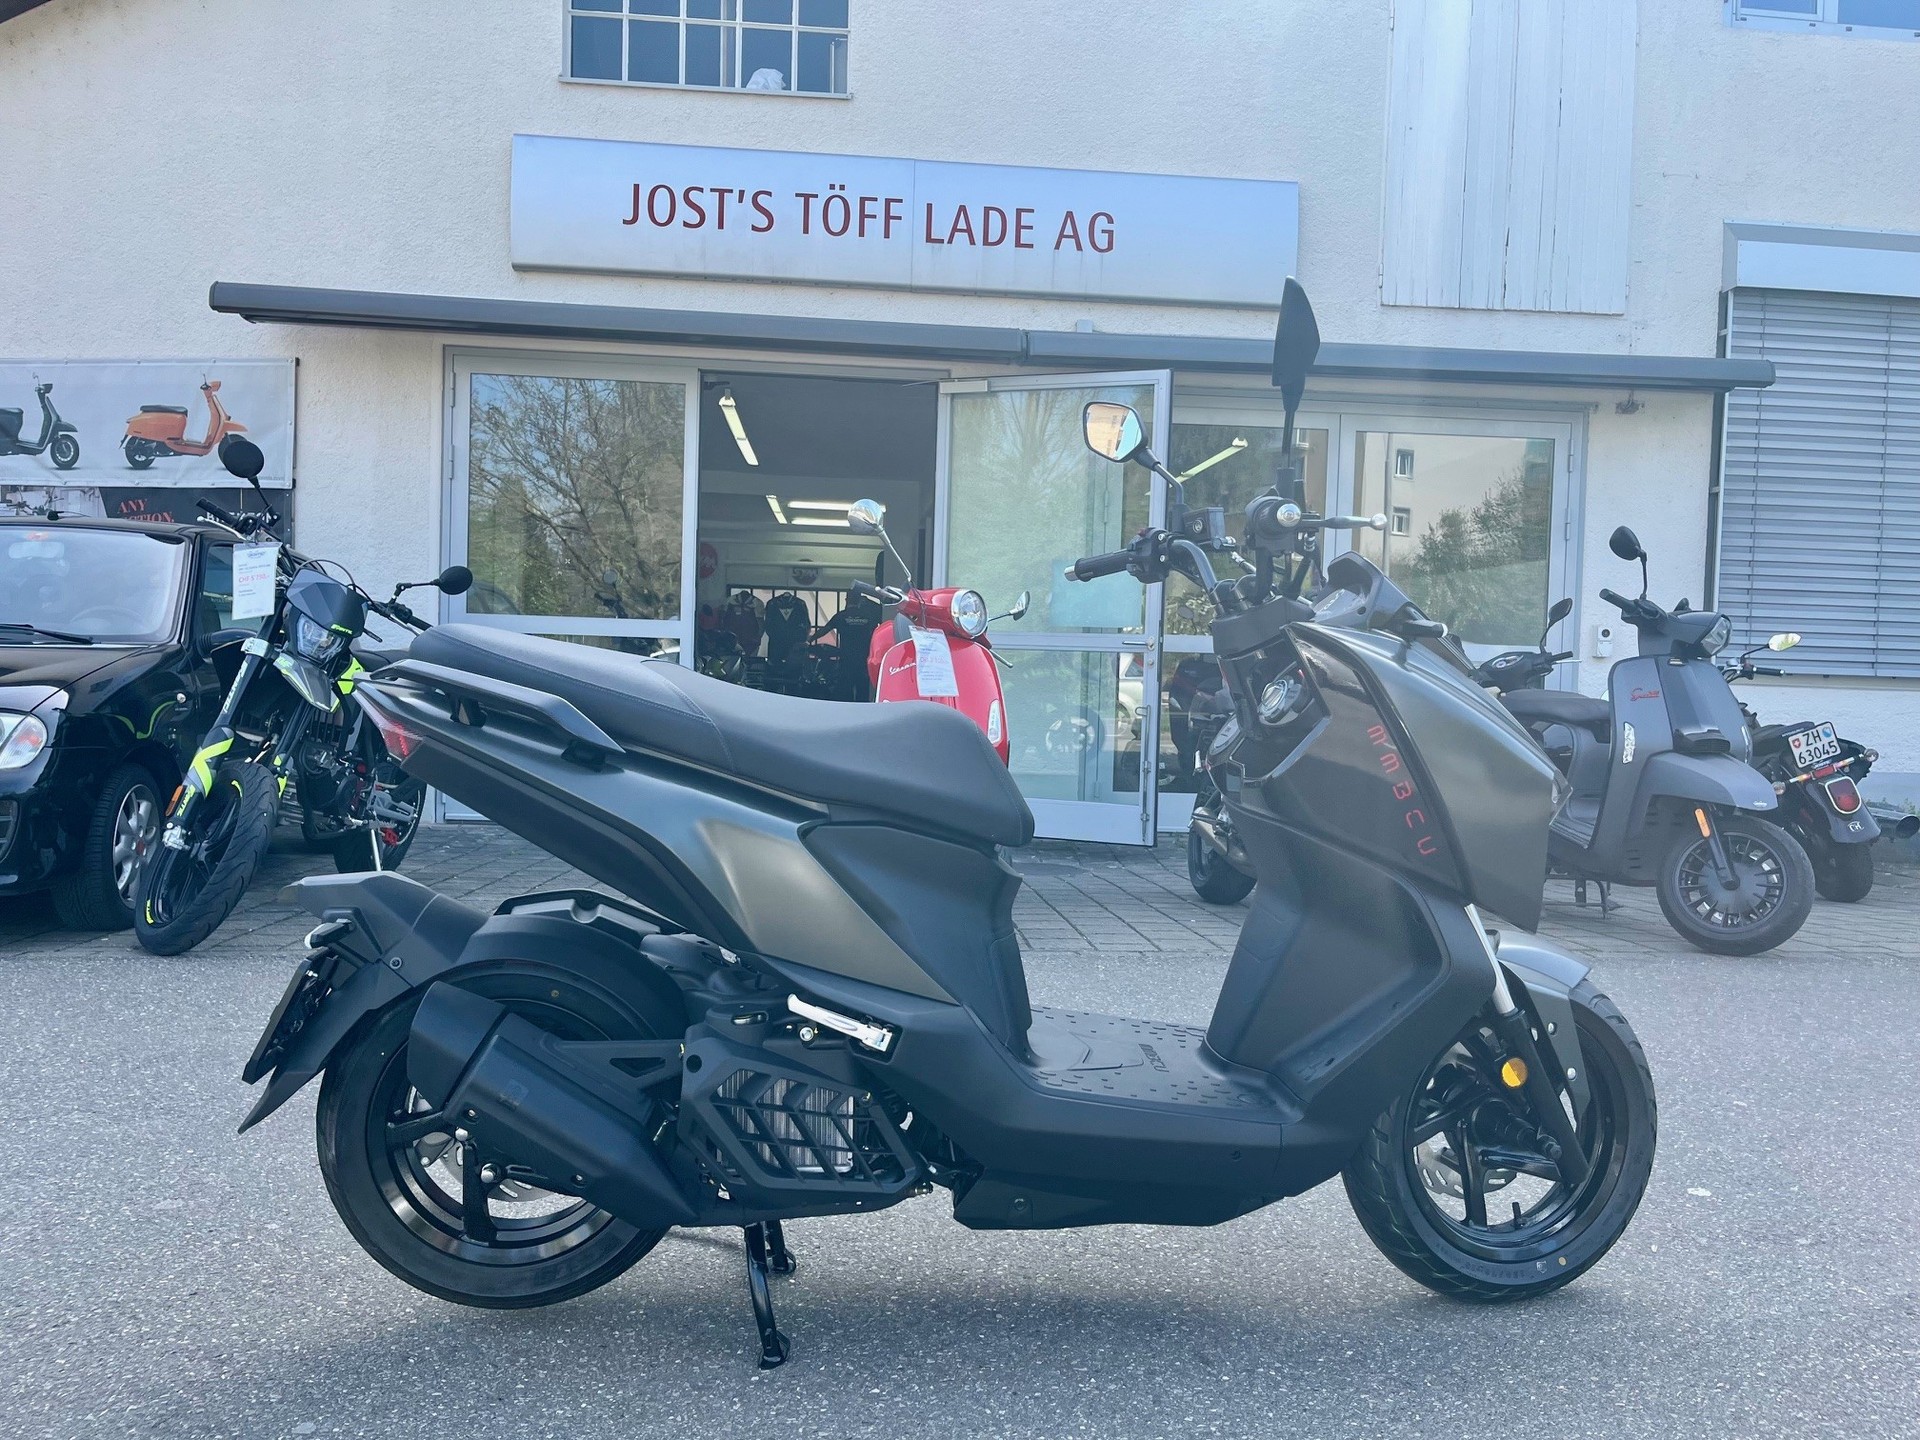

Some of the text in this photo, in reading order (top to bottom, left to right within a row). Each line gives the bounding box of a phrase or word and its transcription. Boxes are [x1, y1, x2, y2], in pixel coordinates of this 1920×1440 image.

[622, 183, 1115, 253] JOST'S TÖFF LADE AG
[117, 498, 148, 514] ANY
[1803, 729, 1822, 747] ZH
[1798, 741, 1838, 765] 63045
